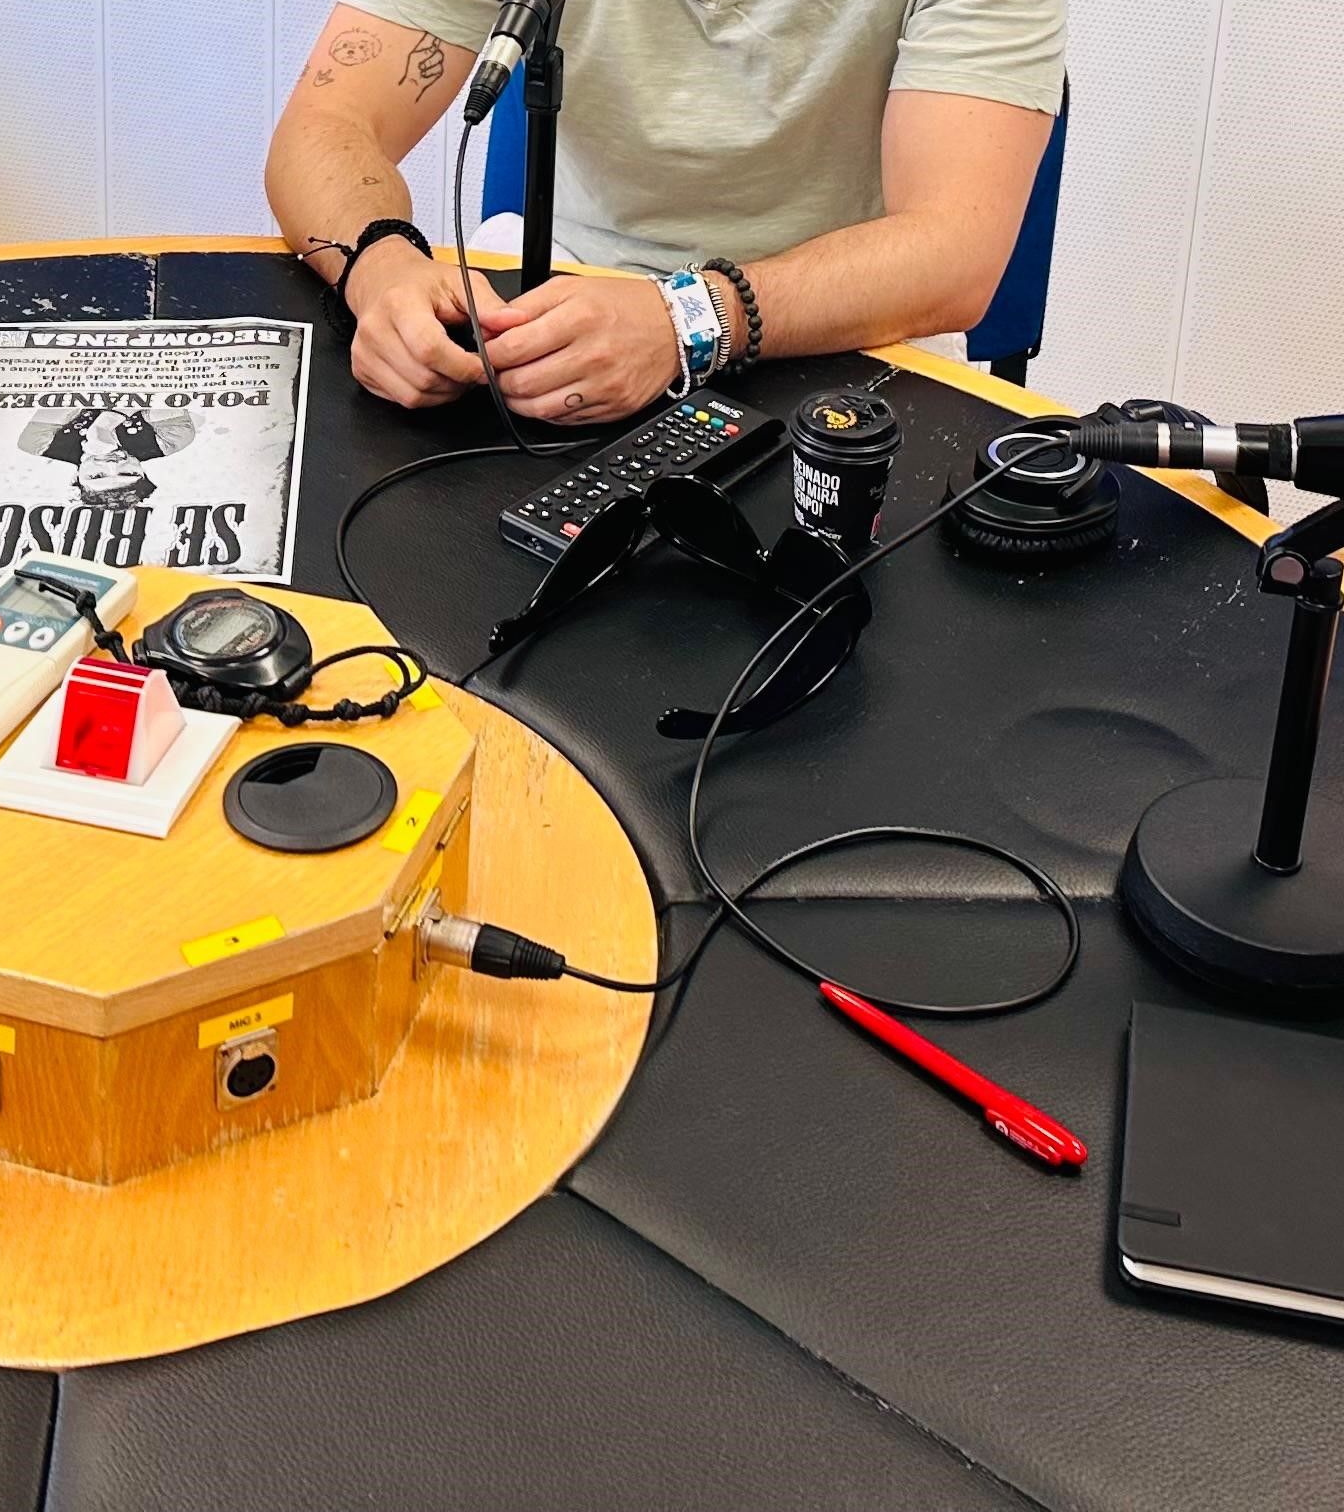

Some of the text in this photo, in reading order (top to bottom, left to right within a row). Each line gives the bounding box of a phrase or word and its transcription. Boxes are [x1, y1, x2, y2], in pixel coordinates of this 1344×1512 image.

[31, 330, 281, 347] RECOMPENSA
[203, 379, 227, 388] por
[231, 379, 269, 387] Visto
[164, 390, 271, 407] POLO
[806, 480, 839, 507] MIRA
[167, 503, 247, 569] SE
[228, 1015, 253, 1031] MIC
